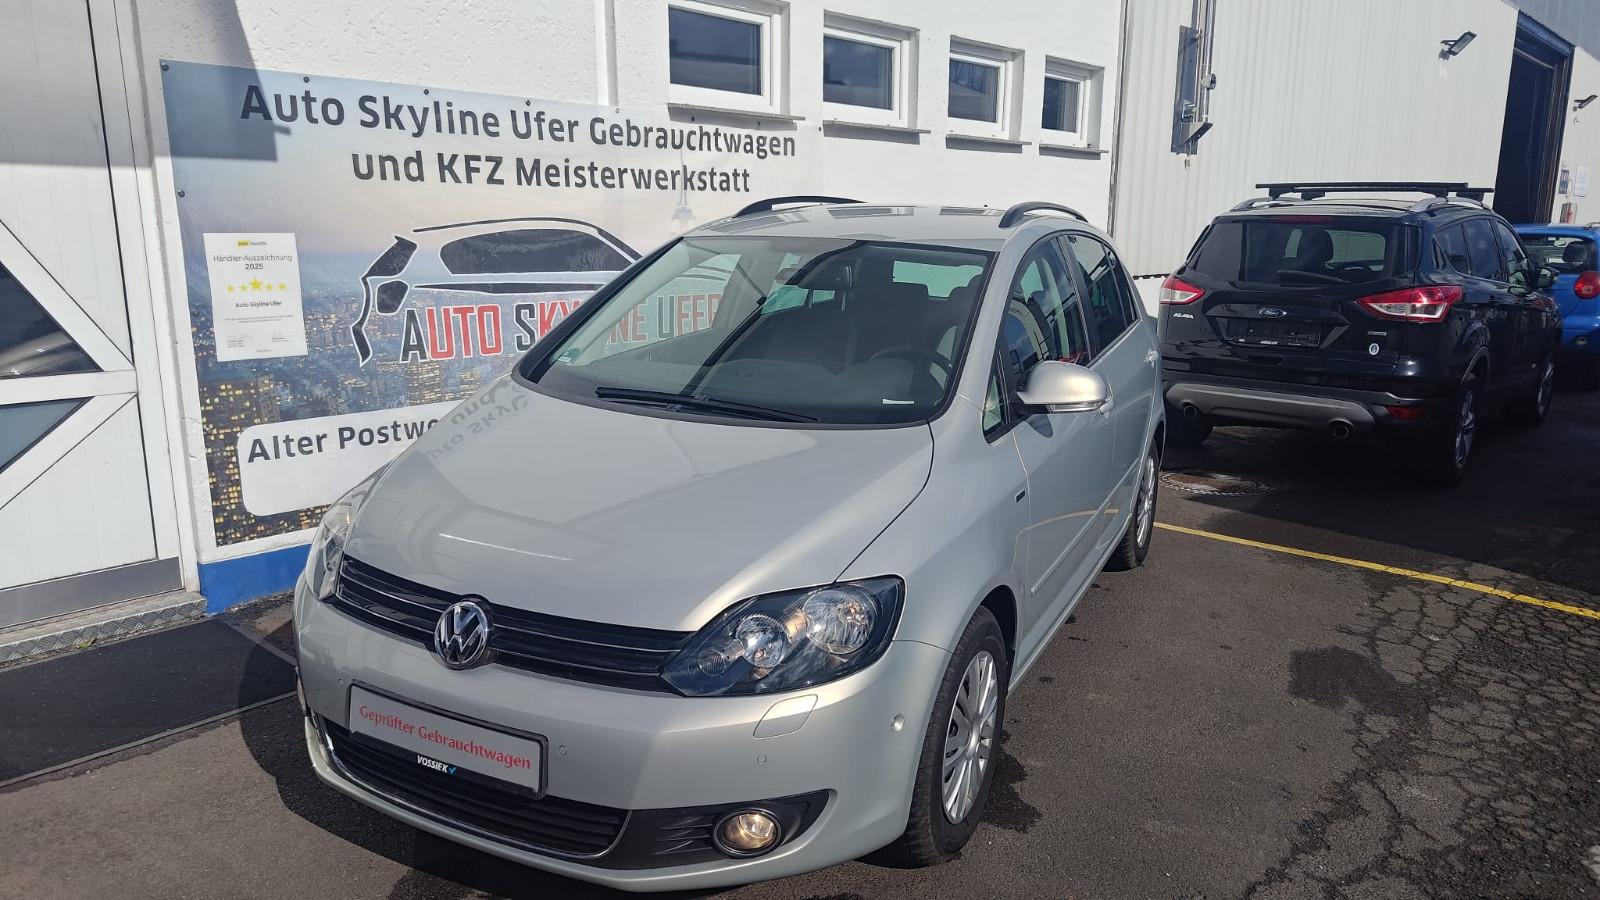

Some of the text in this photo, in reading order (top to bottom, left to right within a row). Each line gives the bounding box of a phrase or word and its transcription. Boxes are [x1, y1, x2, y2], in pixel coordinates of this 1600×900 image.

[240, 84, 796, 159] Auto Skyline Ufer Gebrauchtwagen
[351, 150, 750, 192] und KFZ Meisterwerkstatt
[400, 304, 503, 363] AUTO
[247, 431, 328, 463] Alter
[359, 704, 532, 769] Geprüfter Gebrauchtwagen
[417, 754, 449, 774] VOSSIEK
